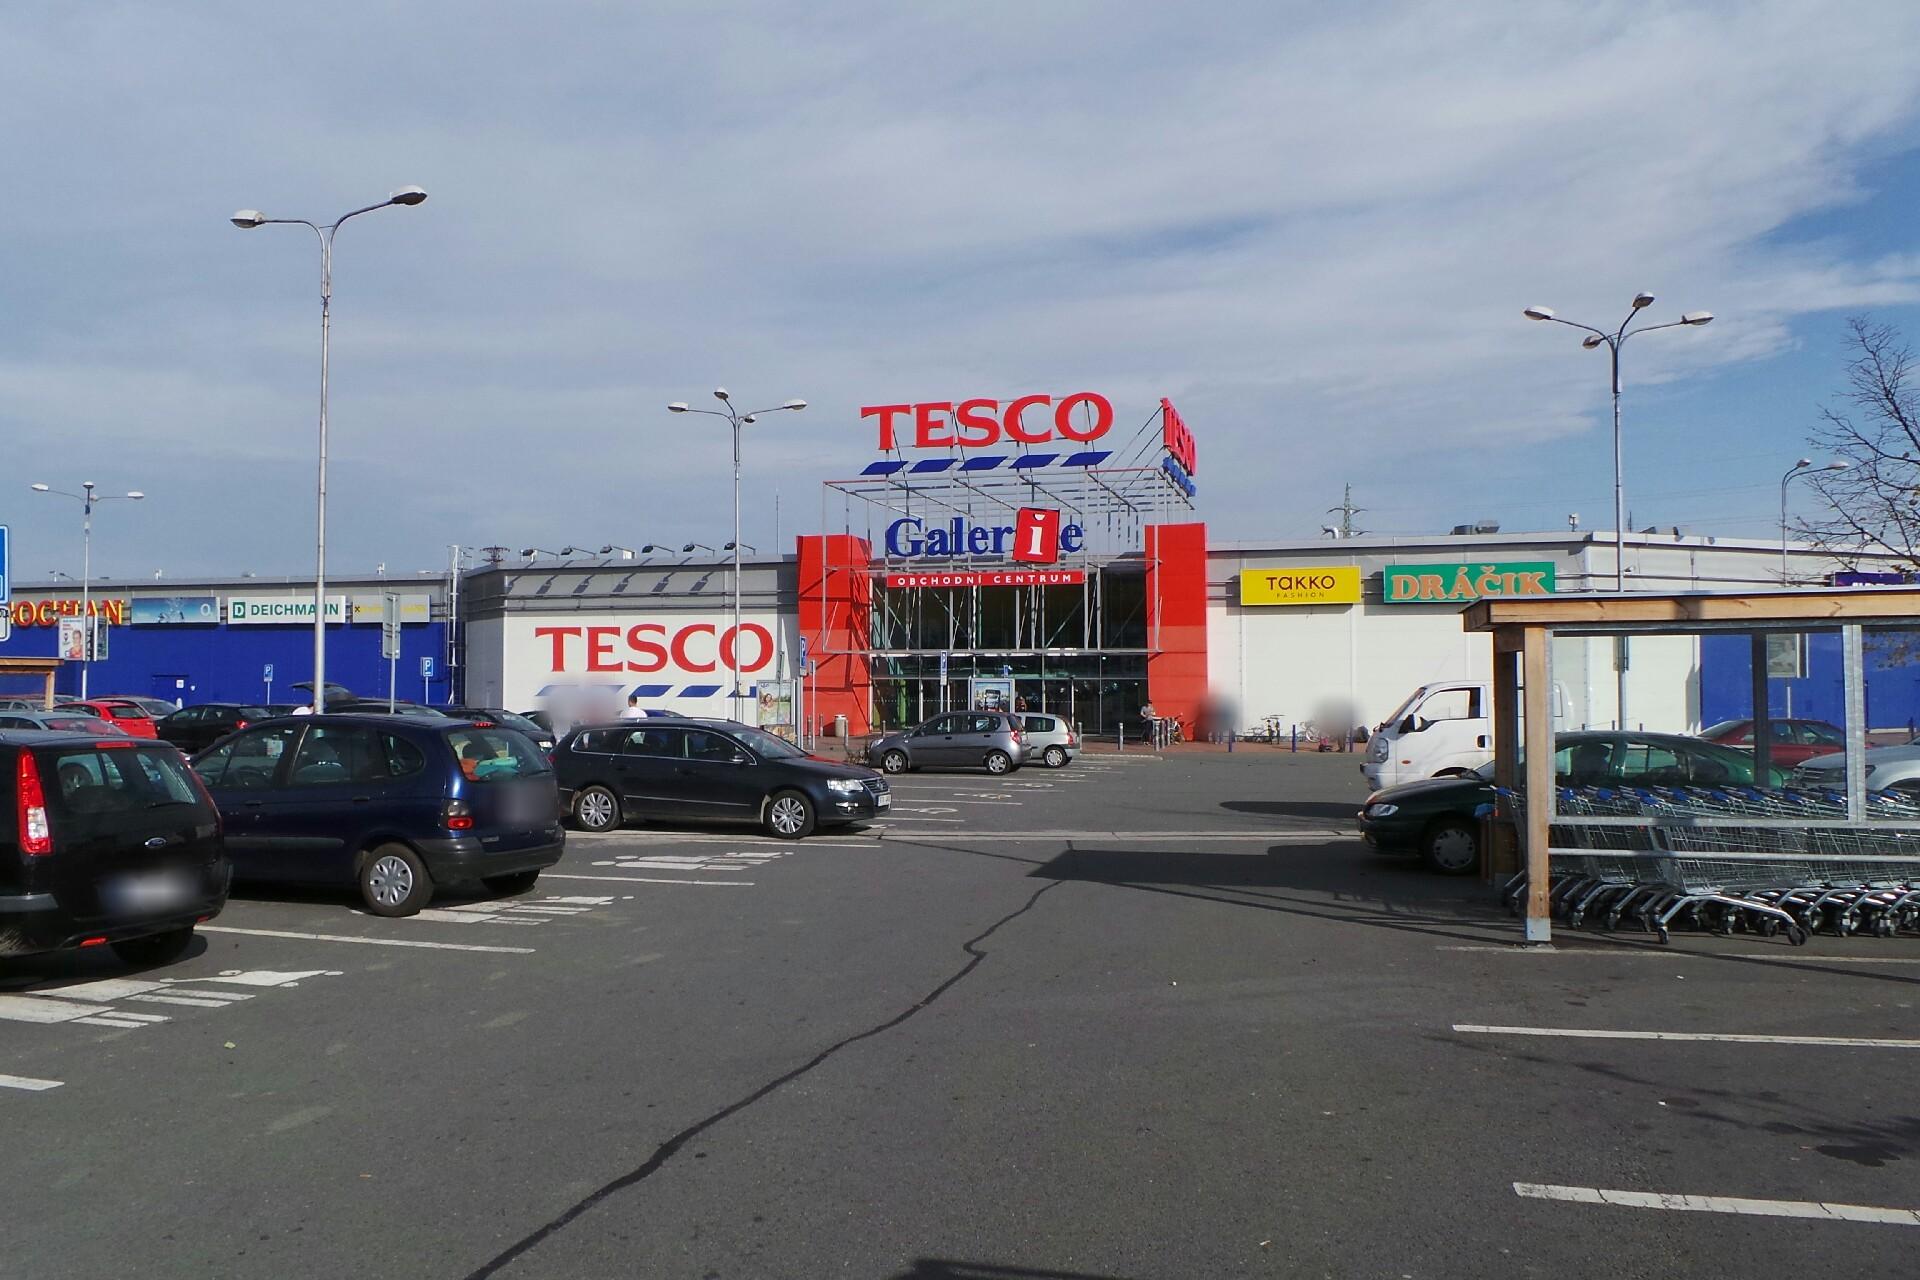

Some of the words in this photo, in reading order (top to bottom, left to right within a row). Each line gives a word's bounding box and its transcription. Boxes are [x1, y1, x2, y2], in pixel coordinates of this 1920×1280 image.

[860, 392, 1113, 450] TESCO
[886, 512, 1084, 558] Galerie
[897, 574, 983, 586] OBCHODNÍ
[993, 573, 1072, 585] CENTRUM
[1276, 591, 1325, 599] FASHION
[1391, 565, 1548, 600] DRÁČIK
[9, 600, 124, 627] OCHAN
[535, 623, 774, 673] TESCO
